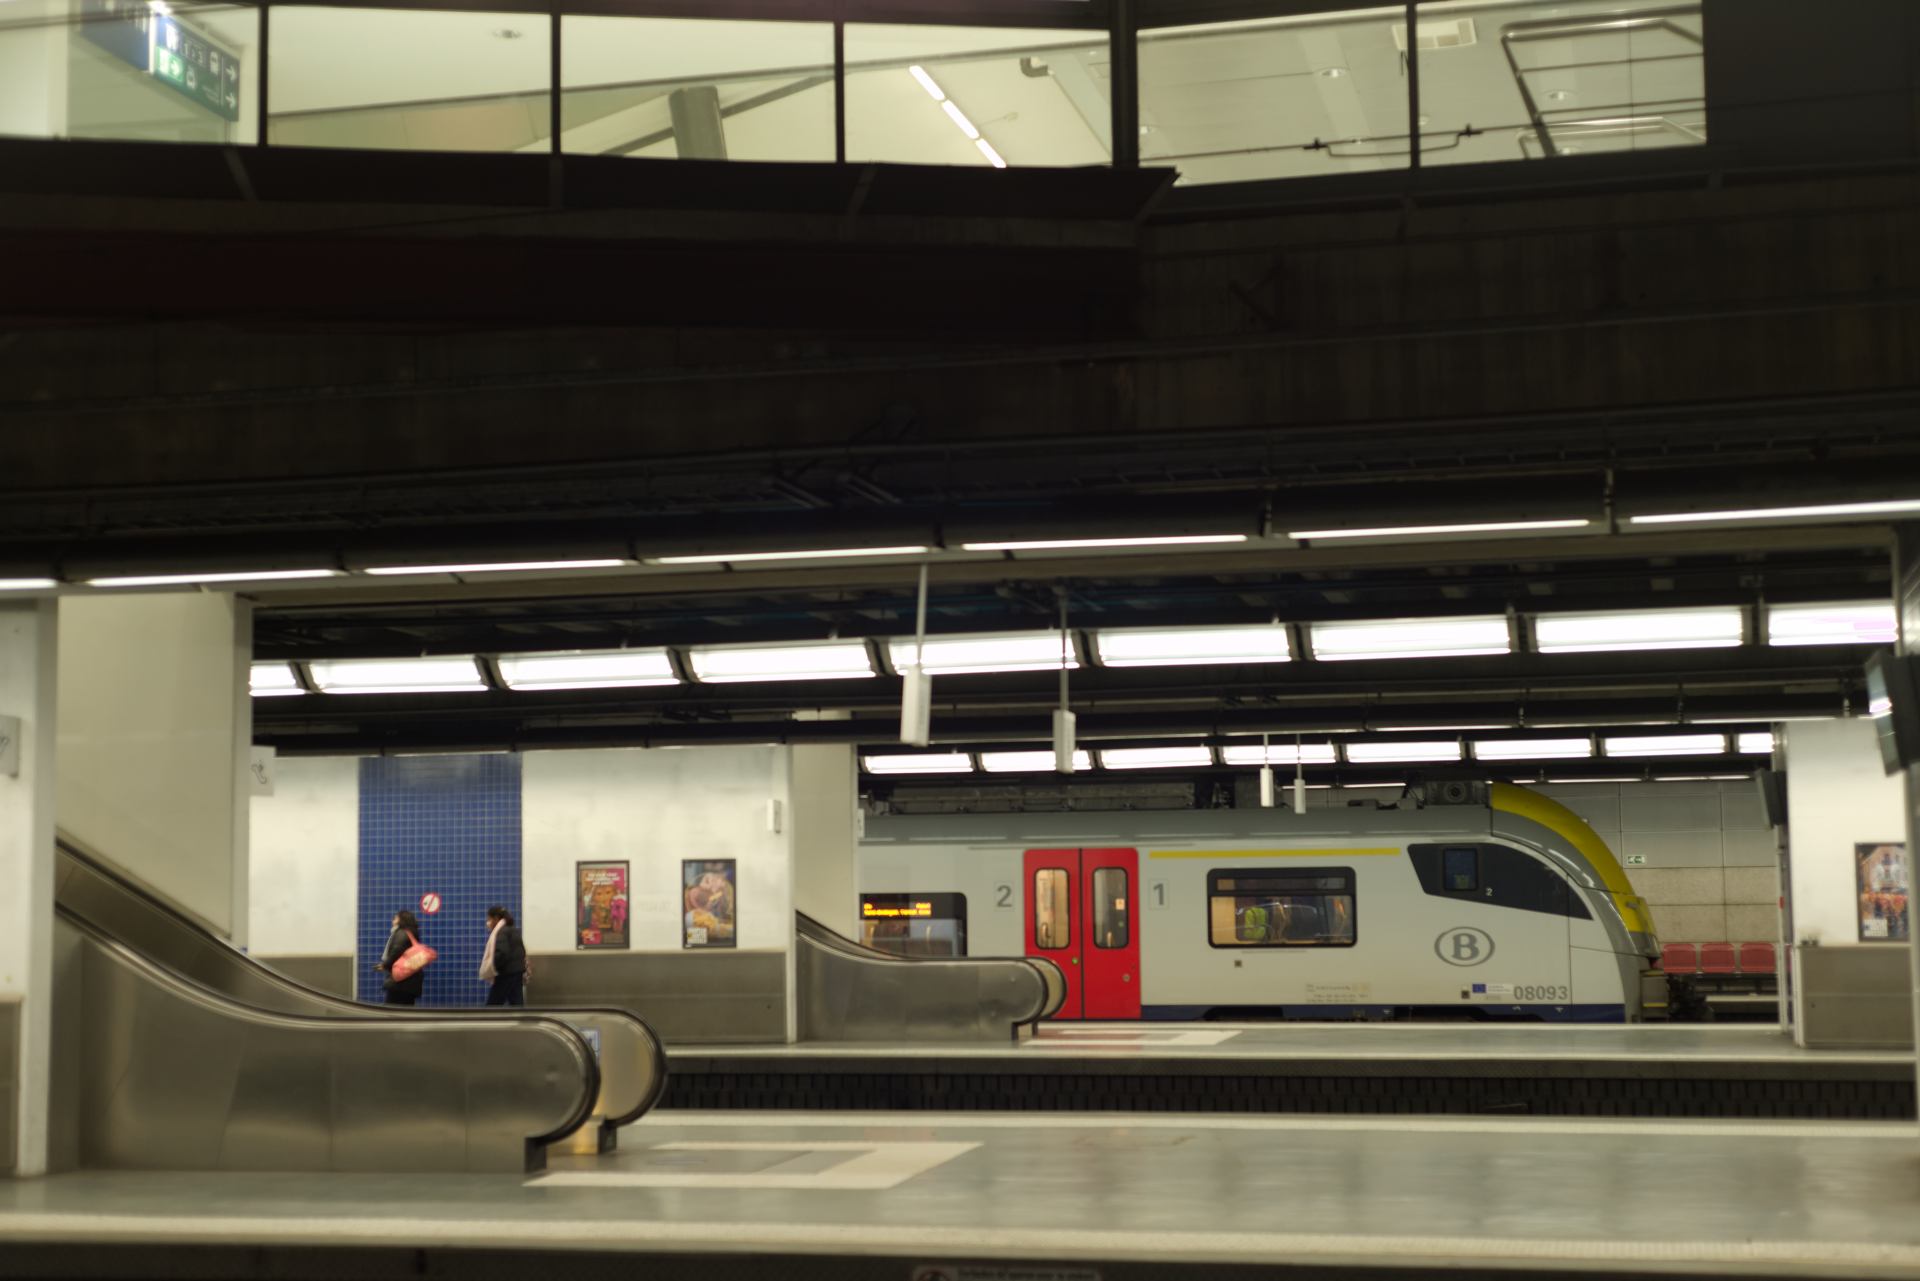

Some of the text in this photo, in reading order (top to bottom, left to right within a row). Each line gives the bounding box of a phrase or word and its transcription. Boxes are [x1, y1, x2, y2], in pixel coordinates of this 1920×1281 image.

[996, 885, 1013, 908] 2
[1153, 883, 1166, 906] 1
[1486, 888, 1493, 896] 2
[1452, 933, 1480, 961] B
[1513, 985, 1568, 1001] 08093
